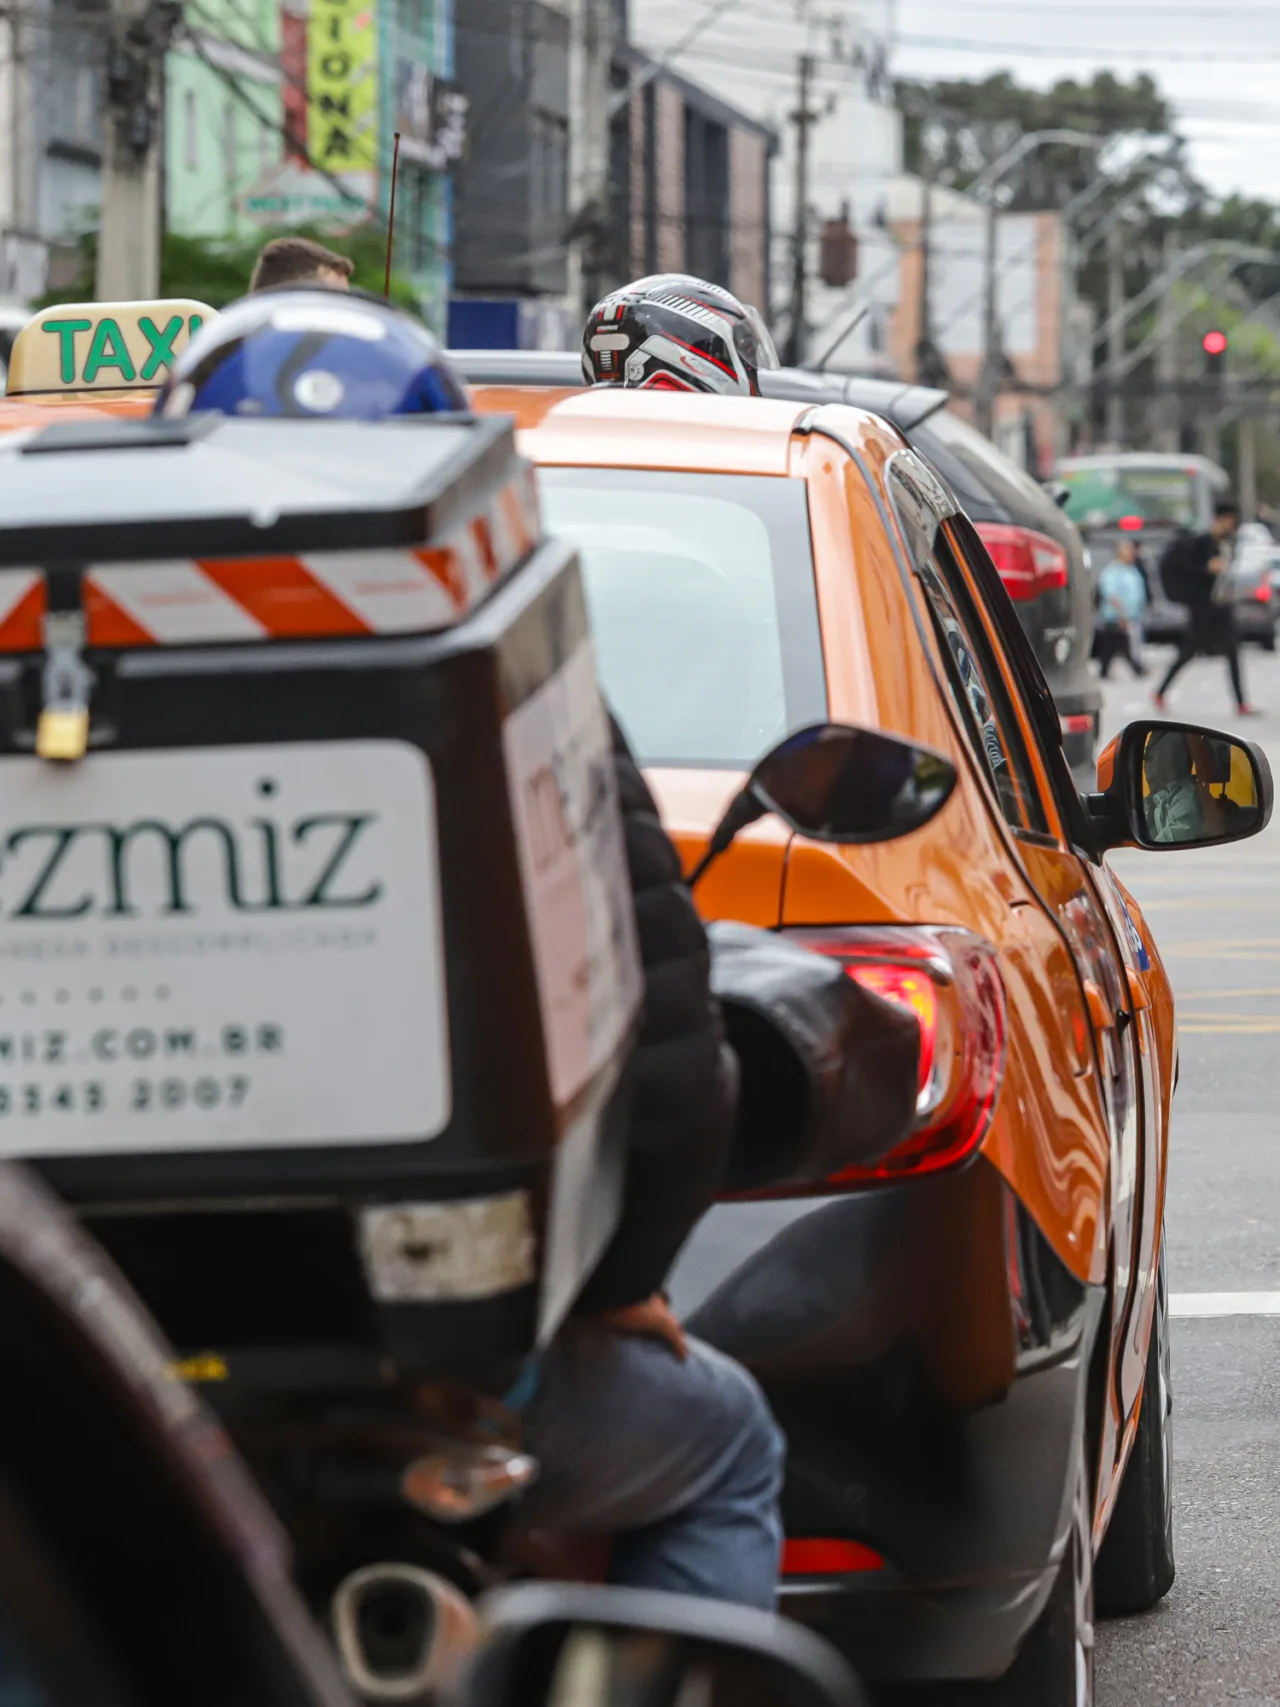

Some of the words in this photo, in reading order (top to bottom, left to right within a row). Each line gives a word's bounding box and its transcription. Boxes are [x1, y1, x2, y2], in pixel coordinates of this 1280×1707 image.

[319, 0, 352, 158] IONA
[0, 776, 385, 922] zmiz
[131, 1072, 251, 1114] 2007
